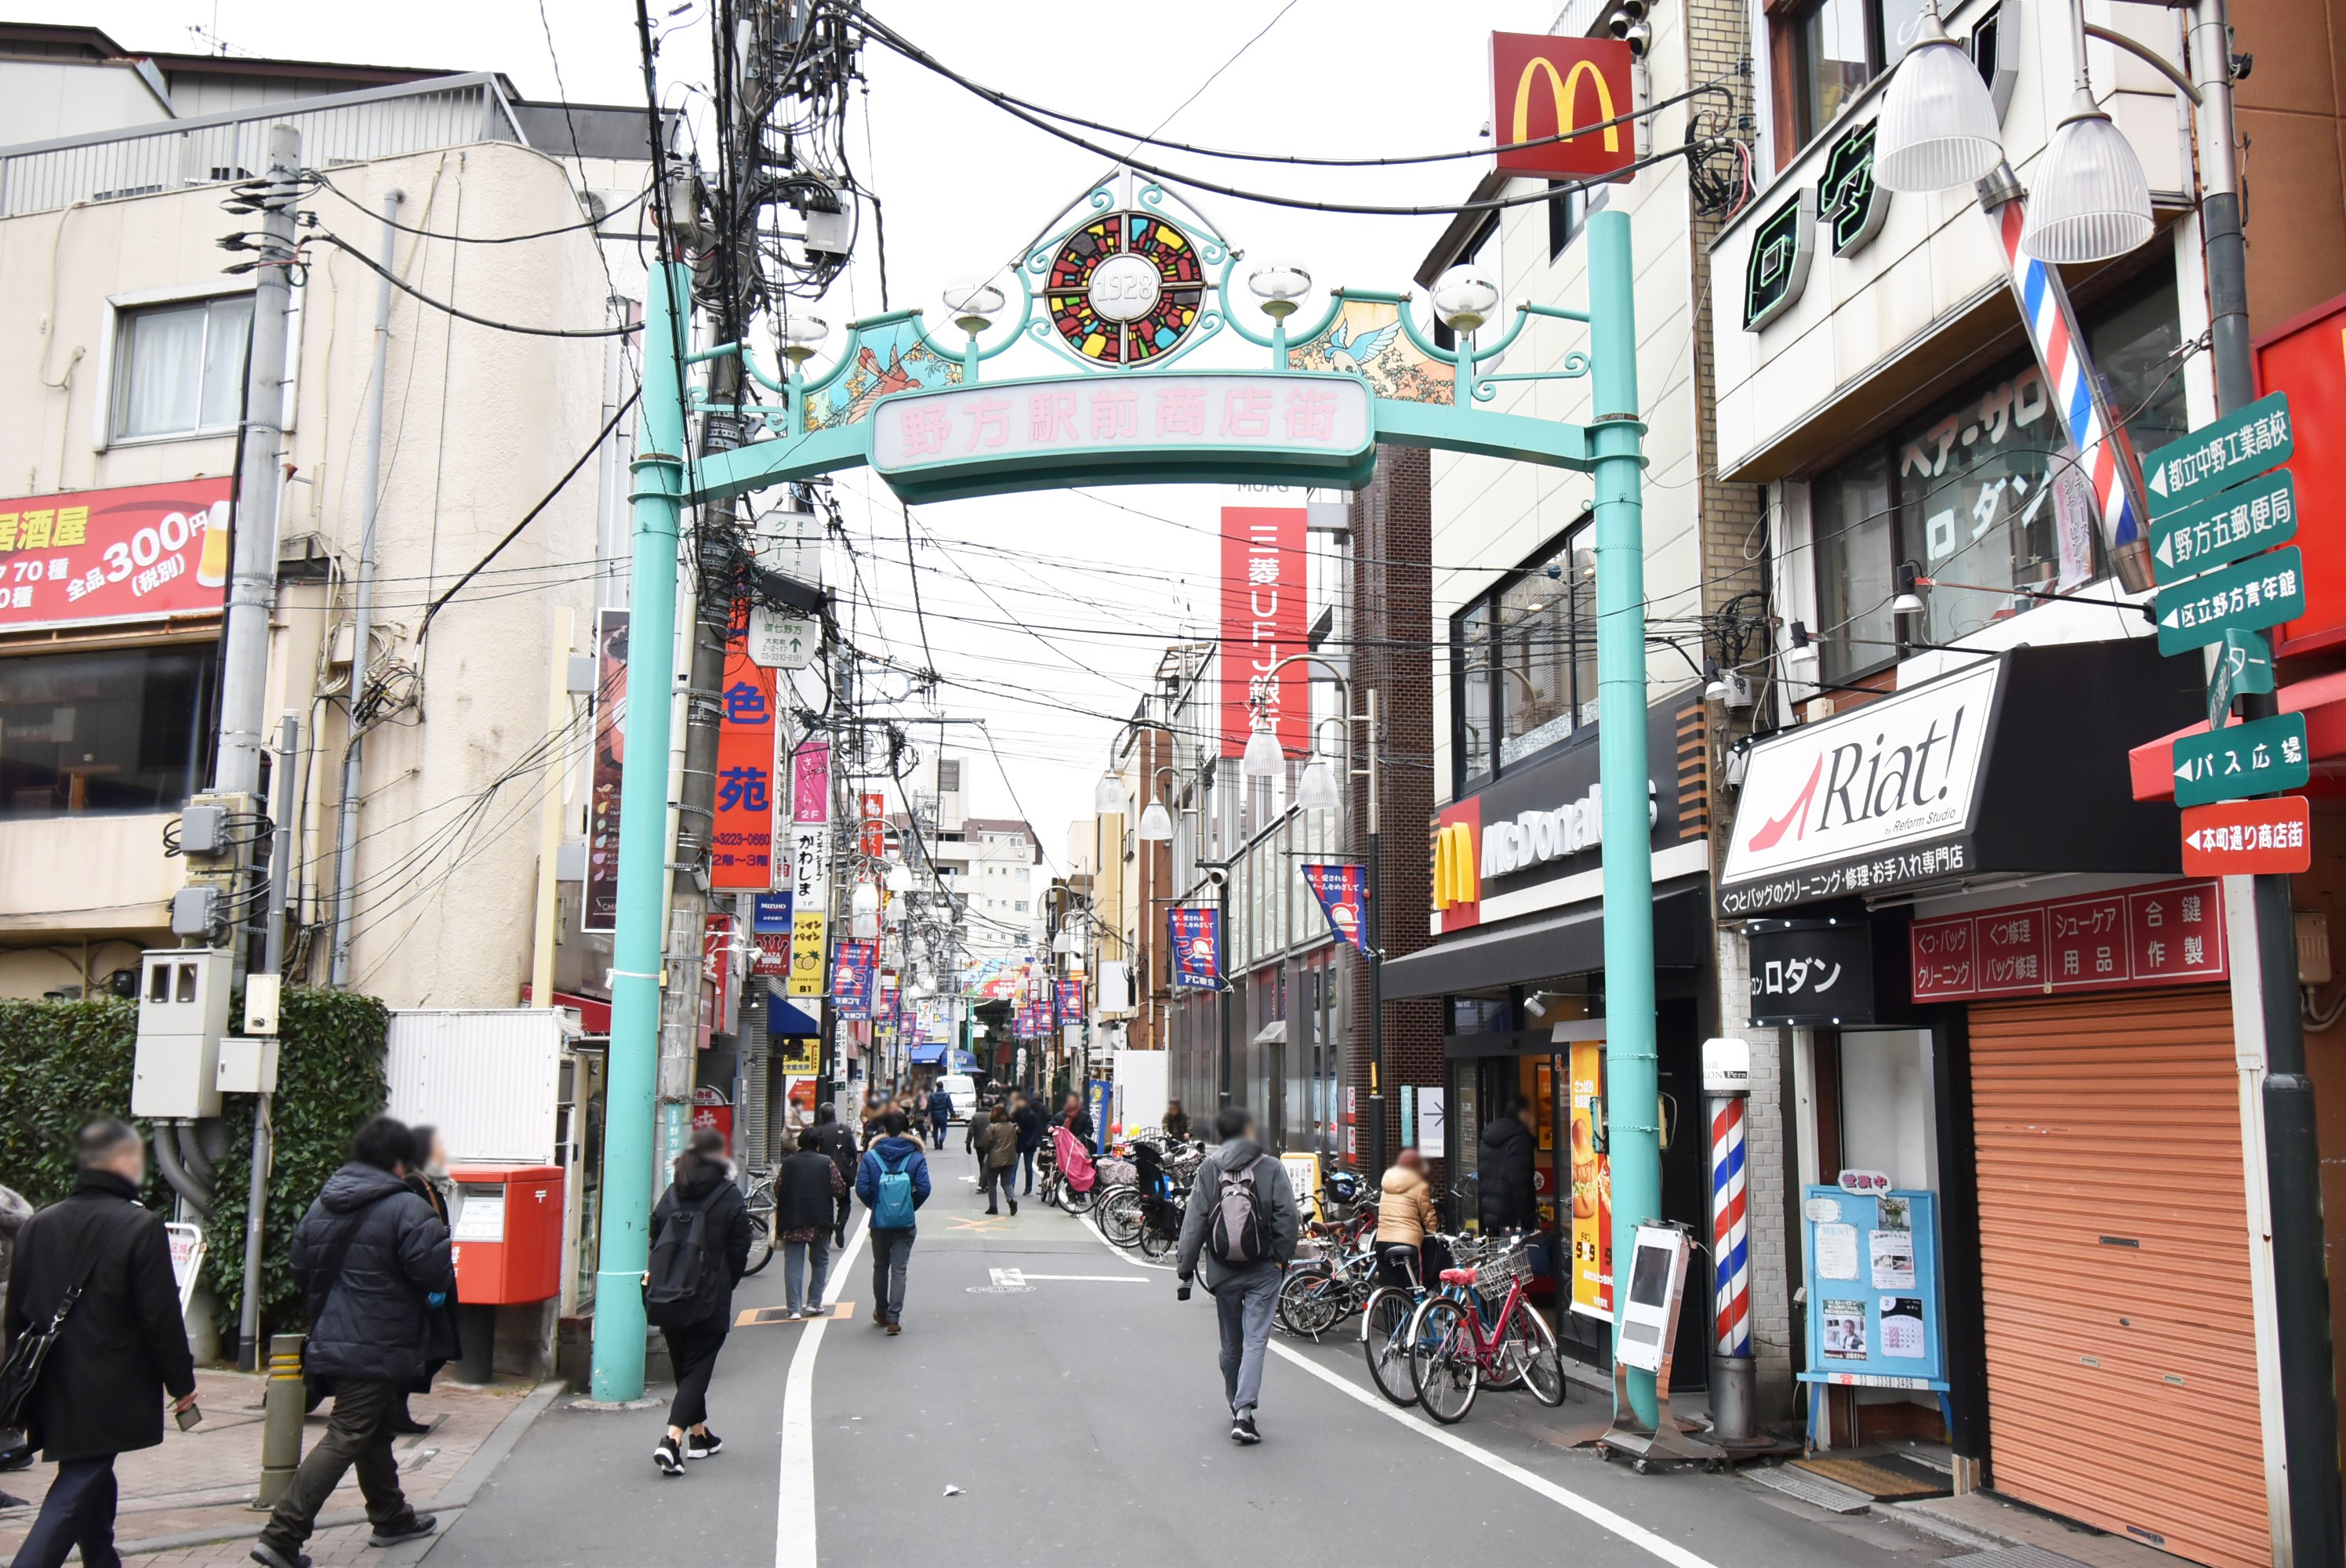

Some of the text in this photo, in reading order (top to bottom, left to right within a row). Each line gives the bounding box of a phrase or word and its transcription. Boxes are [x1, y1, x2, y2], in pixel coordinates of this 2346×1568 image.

[1096, 272, 1153, 302] 1928
[899, 387, 1338, 459] 野方駅前商店街
[1901, 363, 2048, 478] ヘア・サロ
[2168, 410, 2289, 493] 都立中野工業高校
[1926, 469, 2053, 561] ロダン
[2174, 488, 2292, 564] 野方五郵便局
[131, 553, 185, 597] (税別)
[2181, 569, 2297, 628] 区立野方青年館
[1815, 704, 1966, 833] Riat!
[2195, 736, 2301, 781] バス広場
[801, 810, 819, 819] 2F
[1480, 778, 1658, 880] McDonal
[1884, 808, 1956, 836] by Reform Studio
[719, 833, 770, 846] 3223-0660
[2203, 821, 2304, 853] 本町通り商店街
[798, 835, 814, 897] かわしま
[1723, 845, 1963, 913] くつとバッグのクリーニング・修理・お手入れ専門店
[1989, 918, 2031, 946] くつ修理
[2055, 909, 2116, 938] シューケア
[1919, 926, 1969, 955] くつ・バッグ
[2148, 936, 2204, 969] 作製
[1918, 960, 1970, 988] クリーニング
[1986, 954, 2038, 982] バッグ修理
[2064, 946, 2115, 975] 用品
[1185, 975, 1215, 987] FC東京
[1766, 958, 1842, 995] ロダン
[1843, 1174, 1888, 1189] 営業中
[1580, 1232, 1591, 1241] チキン
[1576, 1242, 1595, 1263] タツタ
[1859, 1376, 1867, 1385] 03
